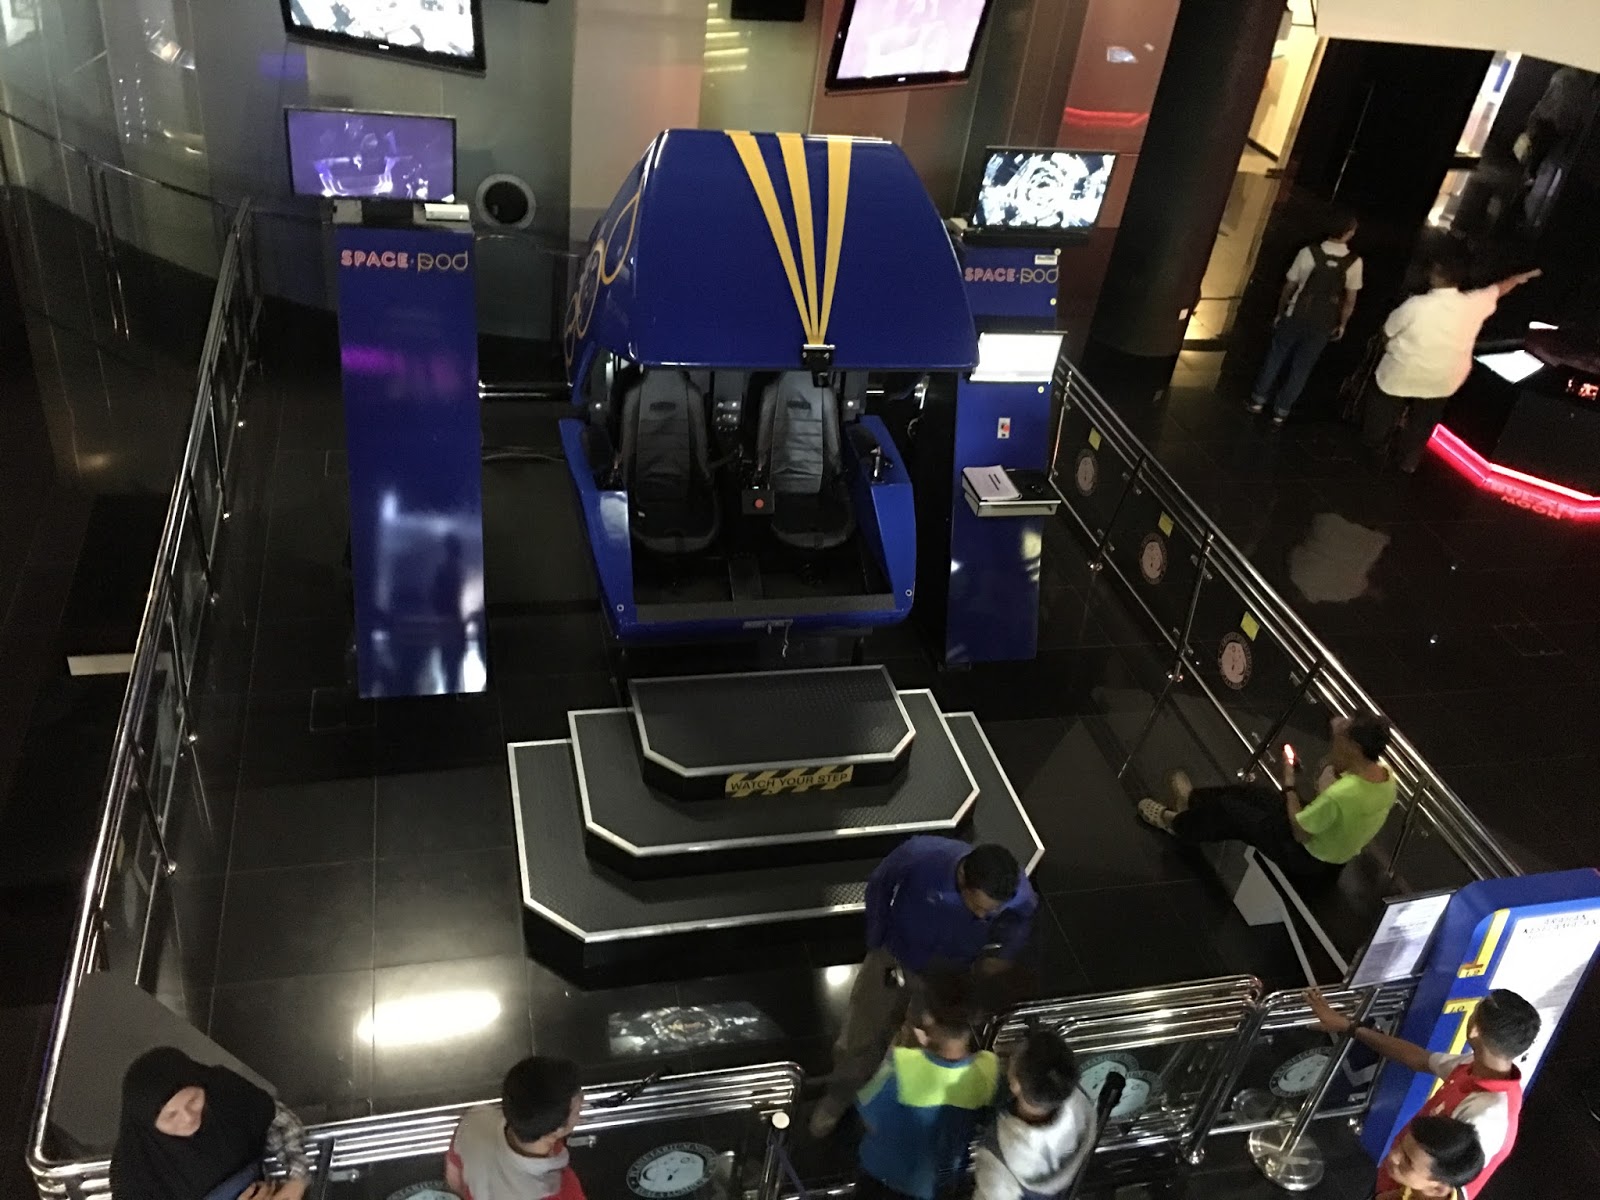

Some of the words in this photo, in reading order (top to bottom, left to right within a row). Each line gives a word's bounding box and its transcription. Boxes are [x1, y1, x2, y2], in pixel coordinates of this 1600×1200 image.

[340, 249, 409, 269] SPACE
[417, 249, 469, 273] pod
[964, 266, 1016, 283] SPACE
[1020, 265, 1060, 285] pod
[1501, 495, 1562, 519] MOON
[731, 779, 776, 791] WATCH
[780, 775, 814, 787] YOUR
[818, 773, 849, 784] STEP
